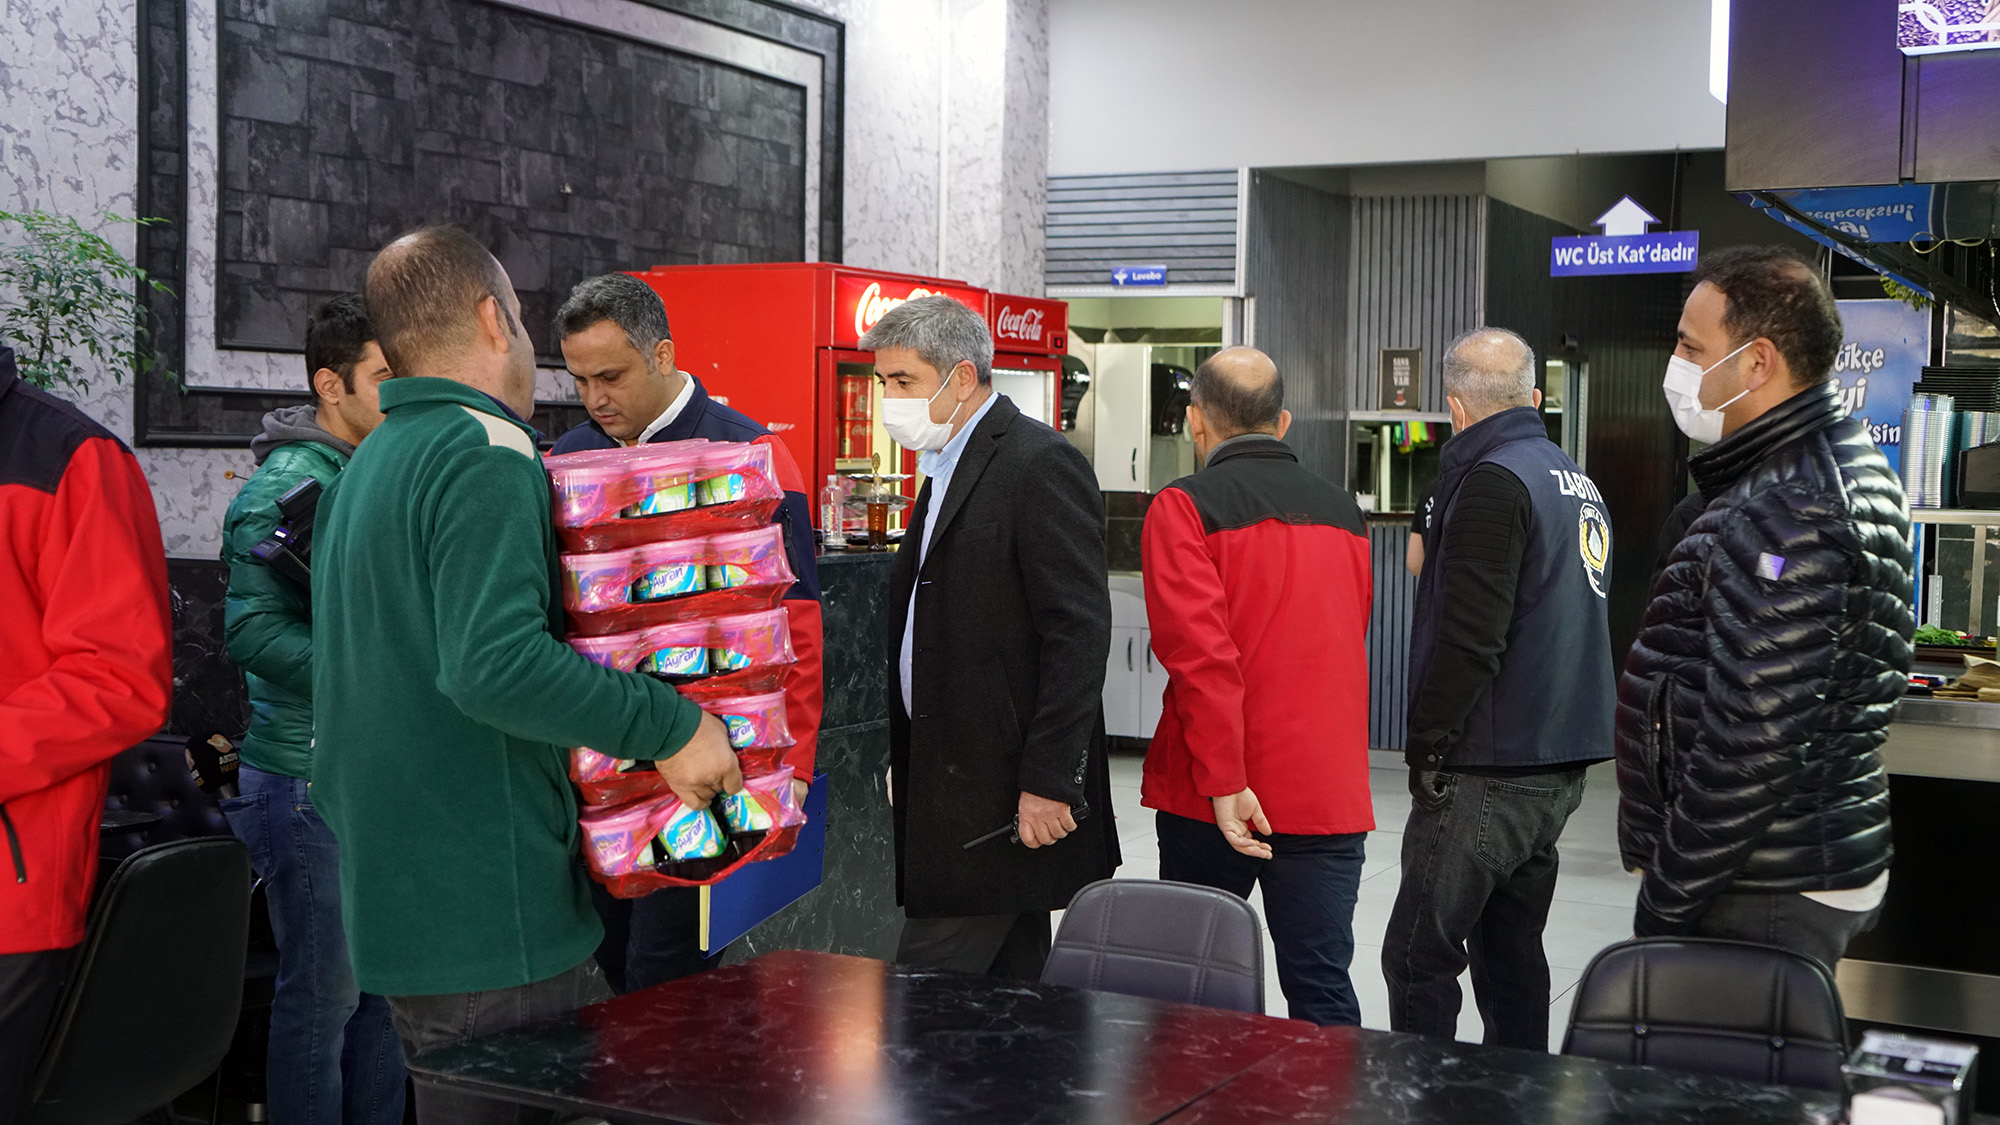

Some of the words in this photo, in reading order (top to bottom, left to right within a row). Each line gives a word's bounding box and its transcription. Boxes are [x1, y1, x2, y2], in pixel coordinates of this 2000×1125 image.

[1555, 247, 1584, 266] WC
[1588, 242, 1614, 265] Üst
[1617, 241, 1695, 264] Kat'dadır
[1132, 271, 1162, 281] Lavabo
[1834, 342, 1884, 373] tikçe
[653, 567, 683, 589] Ayran
[664, 647, 698, 670] Ayran
[730, 722, 755, 741] yran
[678, 819, 705, 849] Ayran
